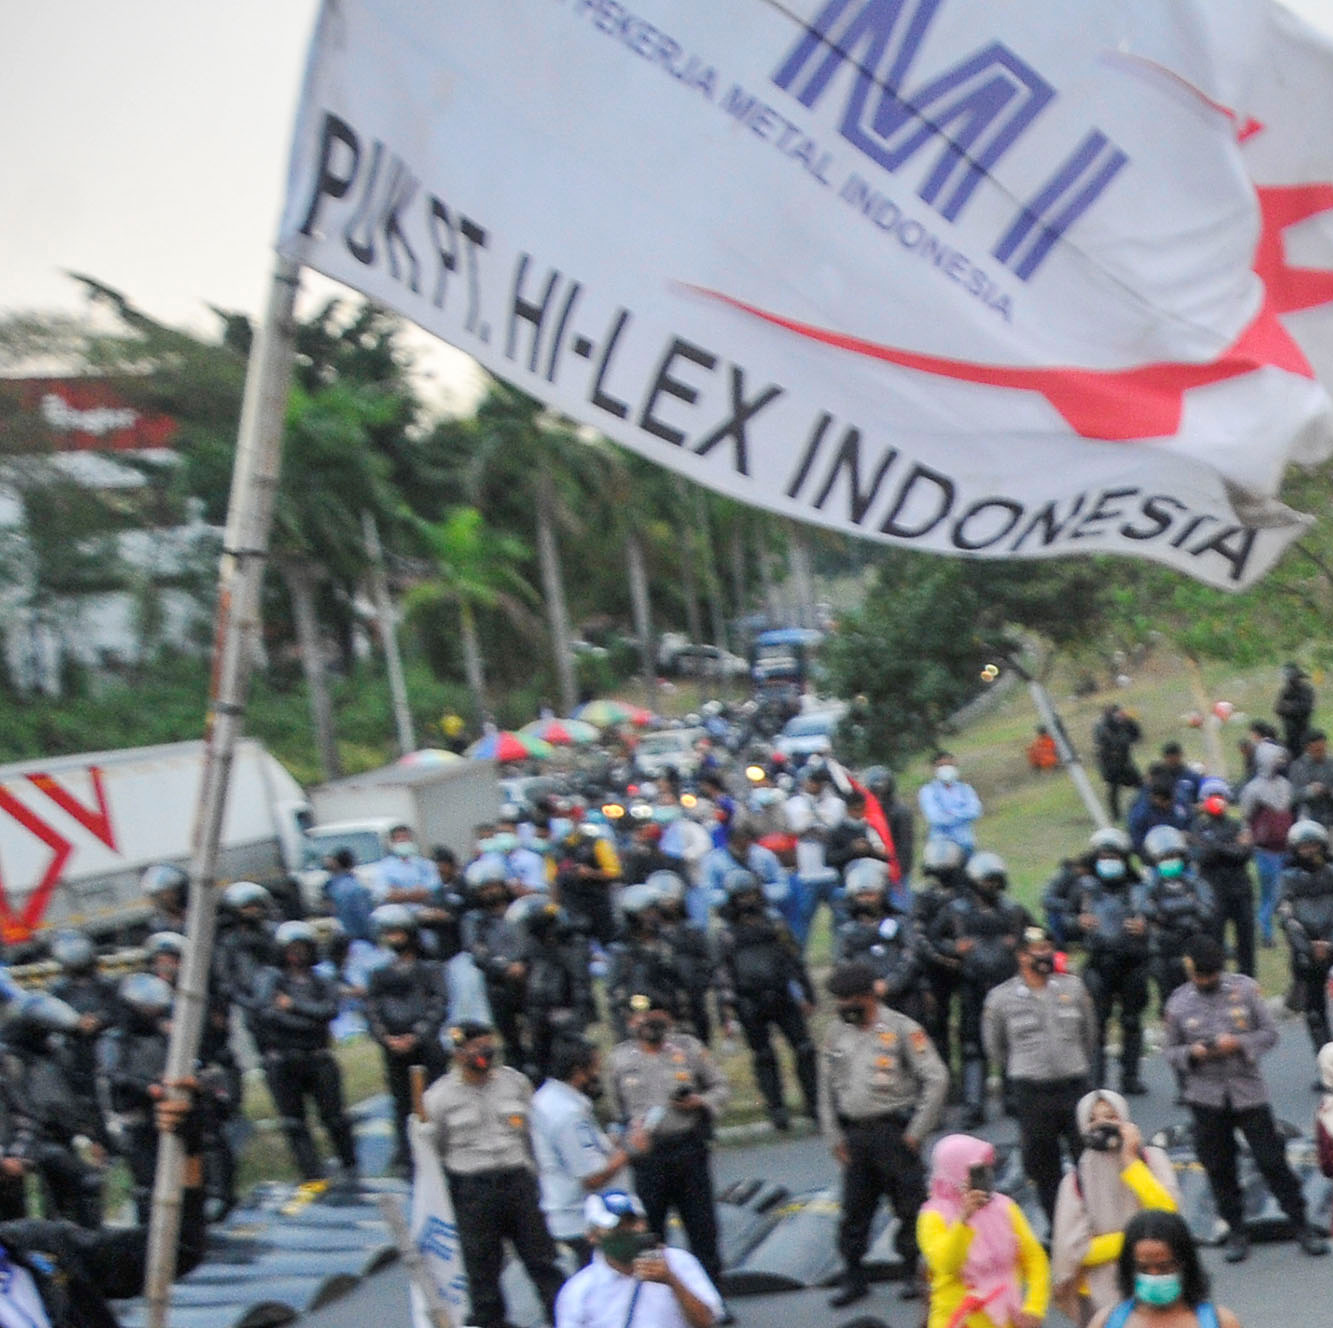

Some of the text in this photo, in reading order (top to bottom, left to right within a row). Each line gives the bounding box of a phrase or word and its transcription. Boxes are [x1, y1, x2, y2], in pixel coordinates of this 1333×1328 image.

[718, 83, 833, 187] METAL
[836, 172, 1016, 323] INDONESIA
[503, 250, 786, 478] HI-LEX
[786, 411, 1260, 582] INDONESIA
